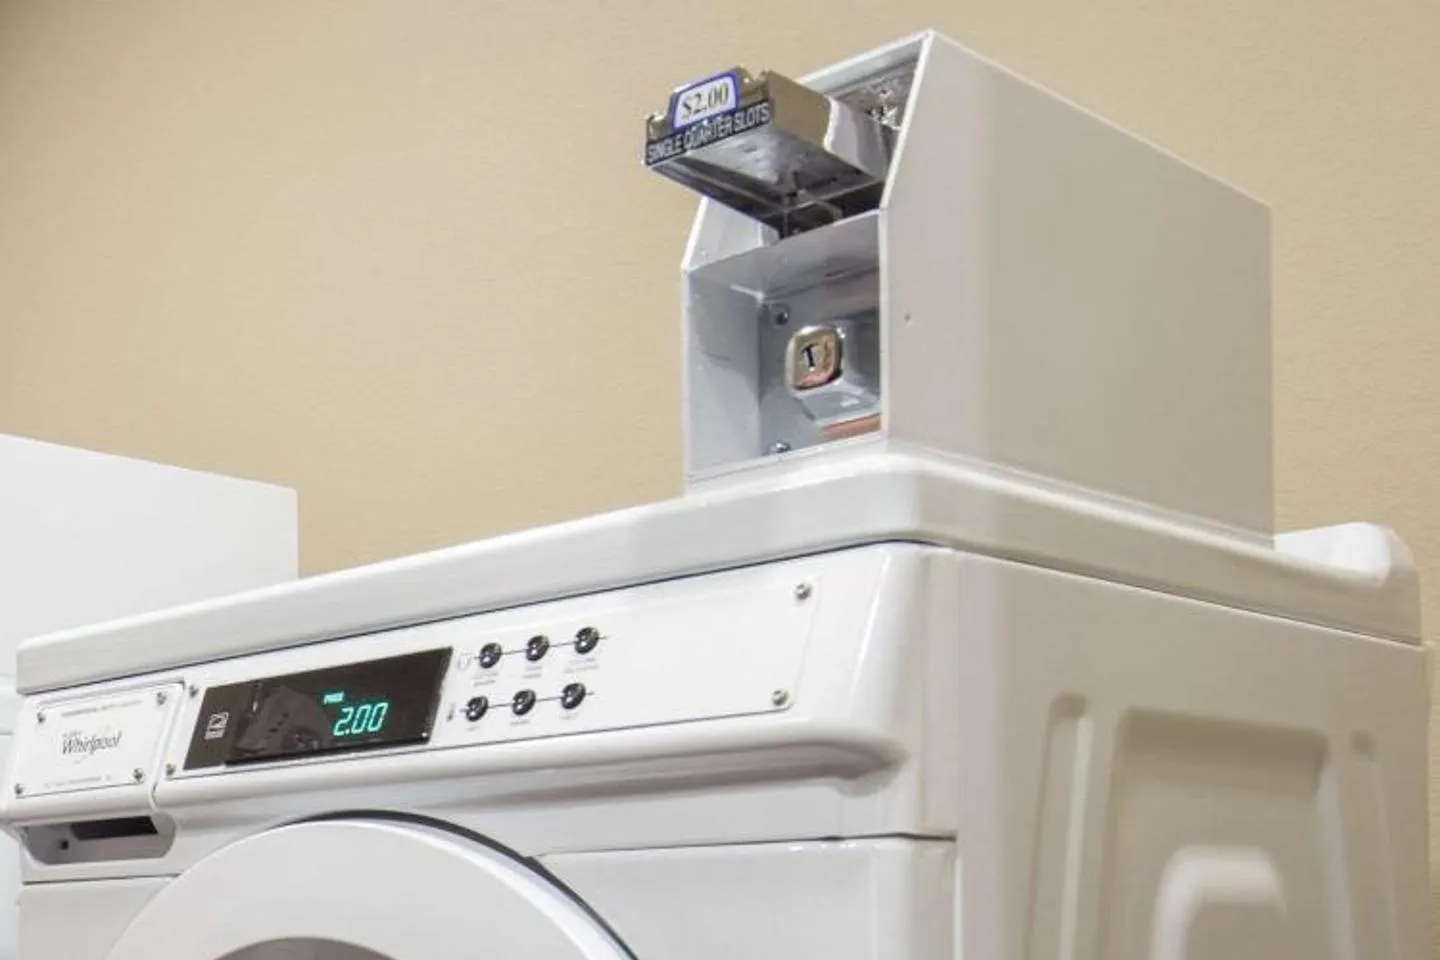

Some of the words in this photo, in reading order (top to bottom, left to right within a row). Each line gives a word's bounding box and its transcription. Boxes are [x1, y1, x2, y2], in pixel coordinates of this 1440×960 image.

[681, 82, 729, 120] $2.00
[684, 118, 733, 149] QUARTER
[734, 101, 771, 131] SLOTS
[333, 702, 389, 736] 2.00
[62, 729, 123, 756] Whirlpool
